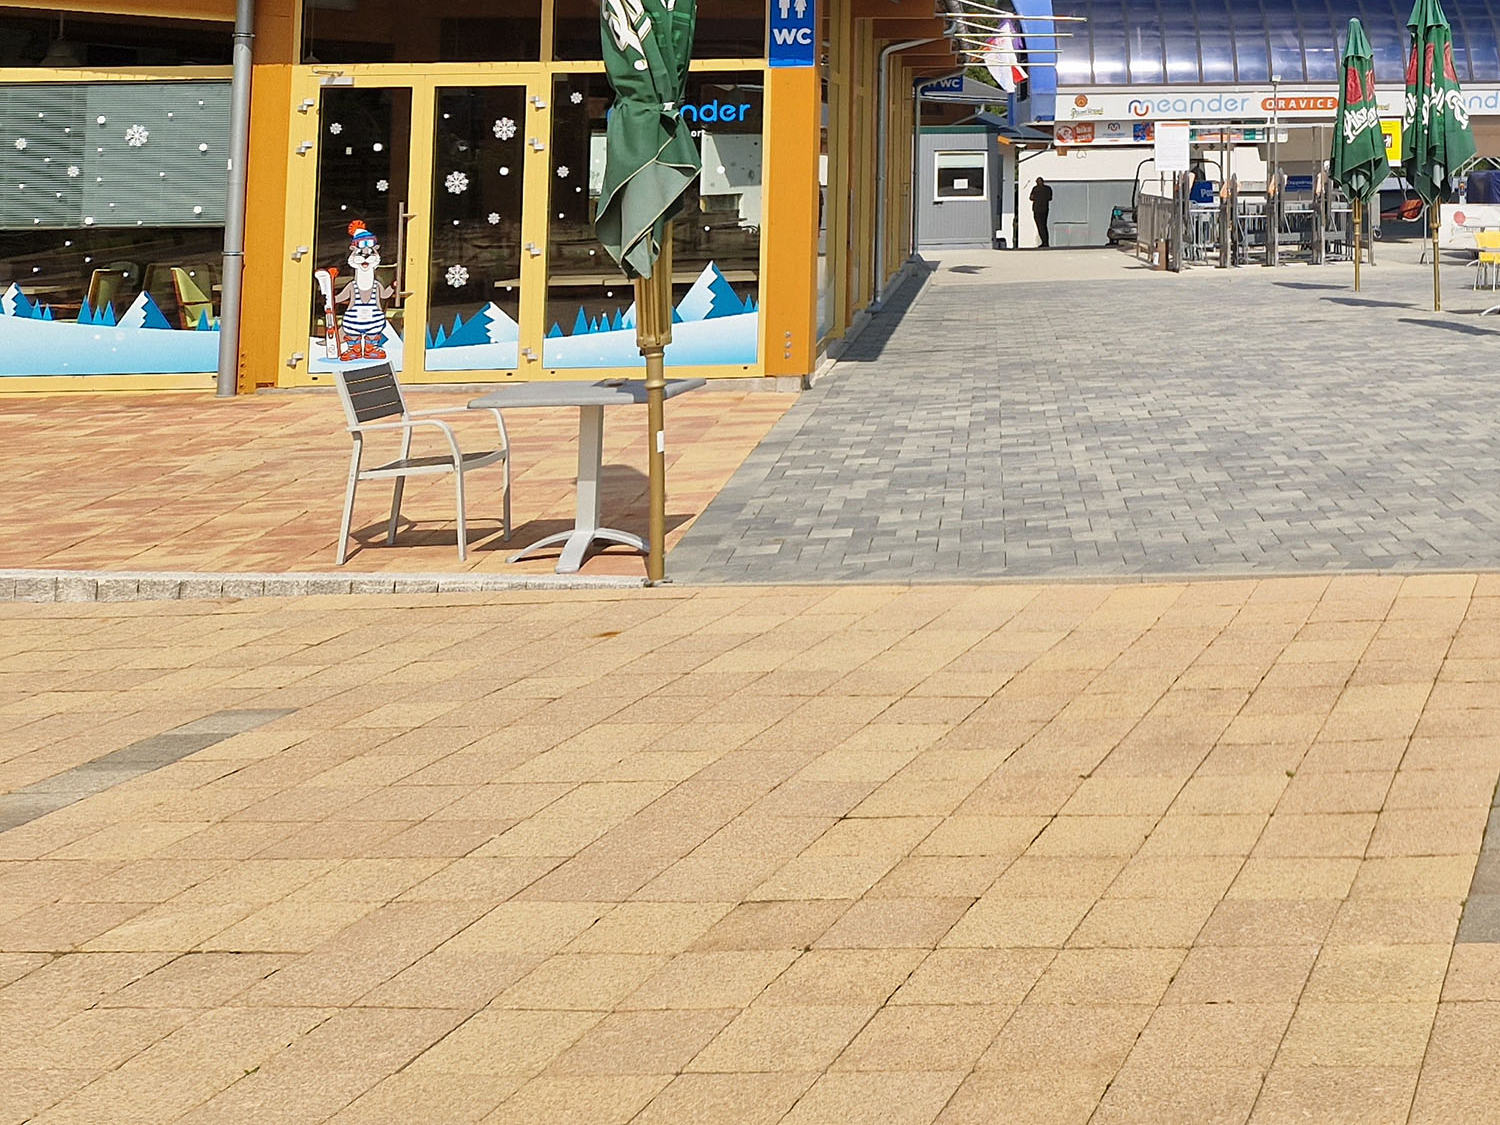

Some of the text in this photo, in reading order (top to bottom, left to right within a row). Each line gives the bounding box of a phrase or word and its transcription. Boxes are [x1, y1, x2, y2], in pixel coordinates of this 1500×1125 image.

[773, 28, 812, 45] WC
[939, 78, 960, 88] WC
[680, 99, 751, 122] nder
[1128, 94, 1334, 116] meander ORAVICE
